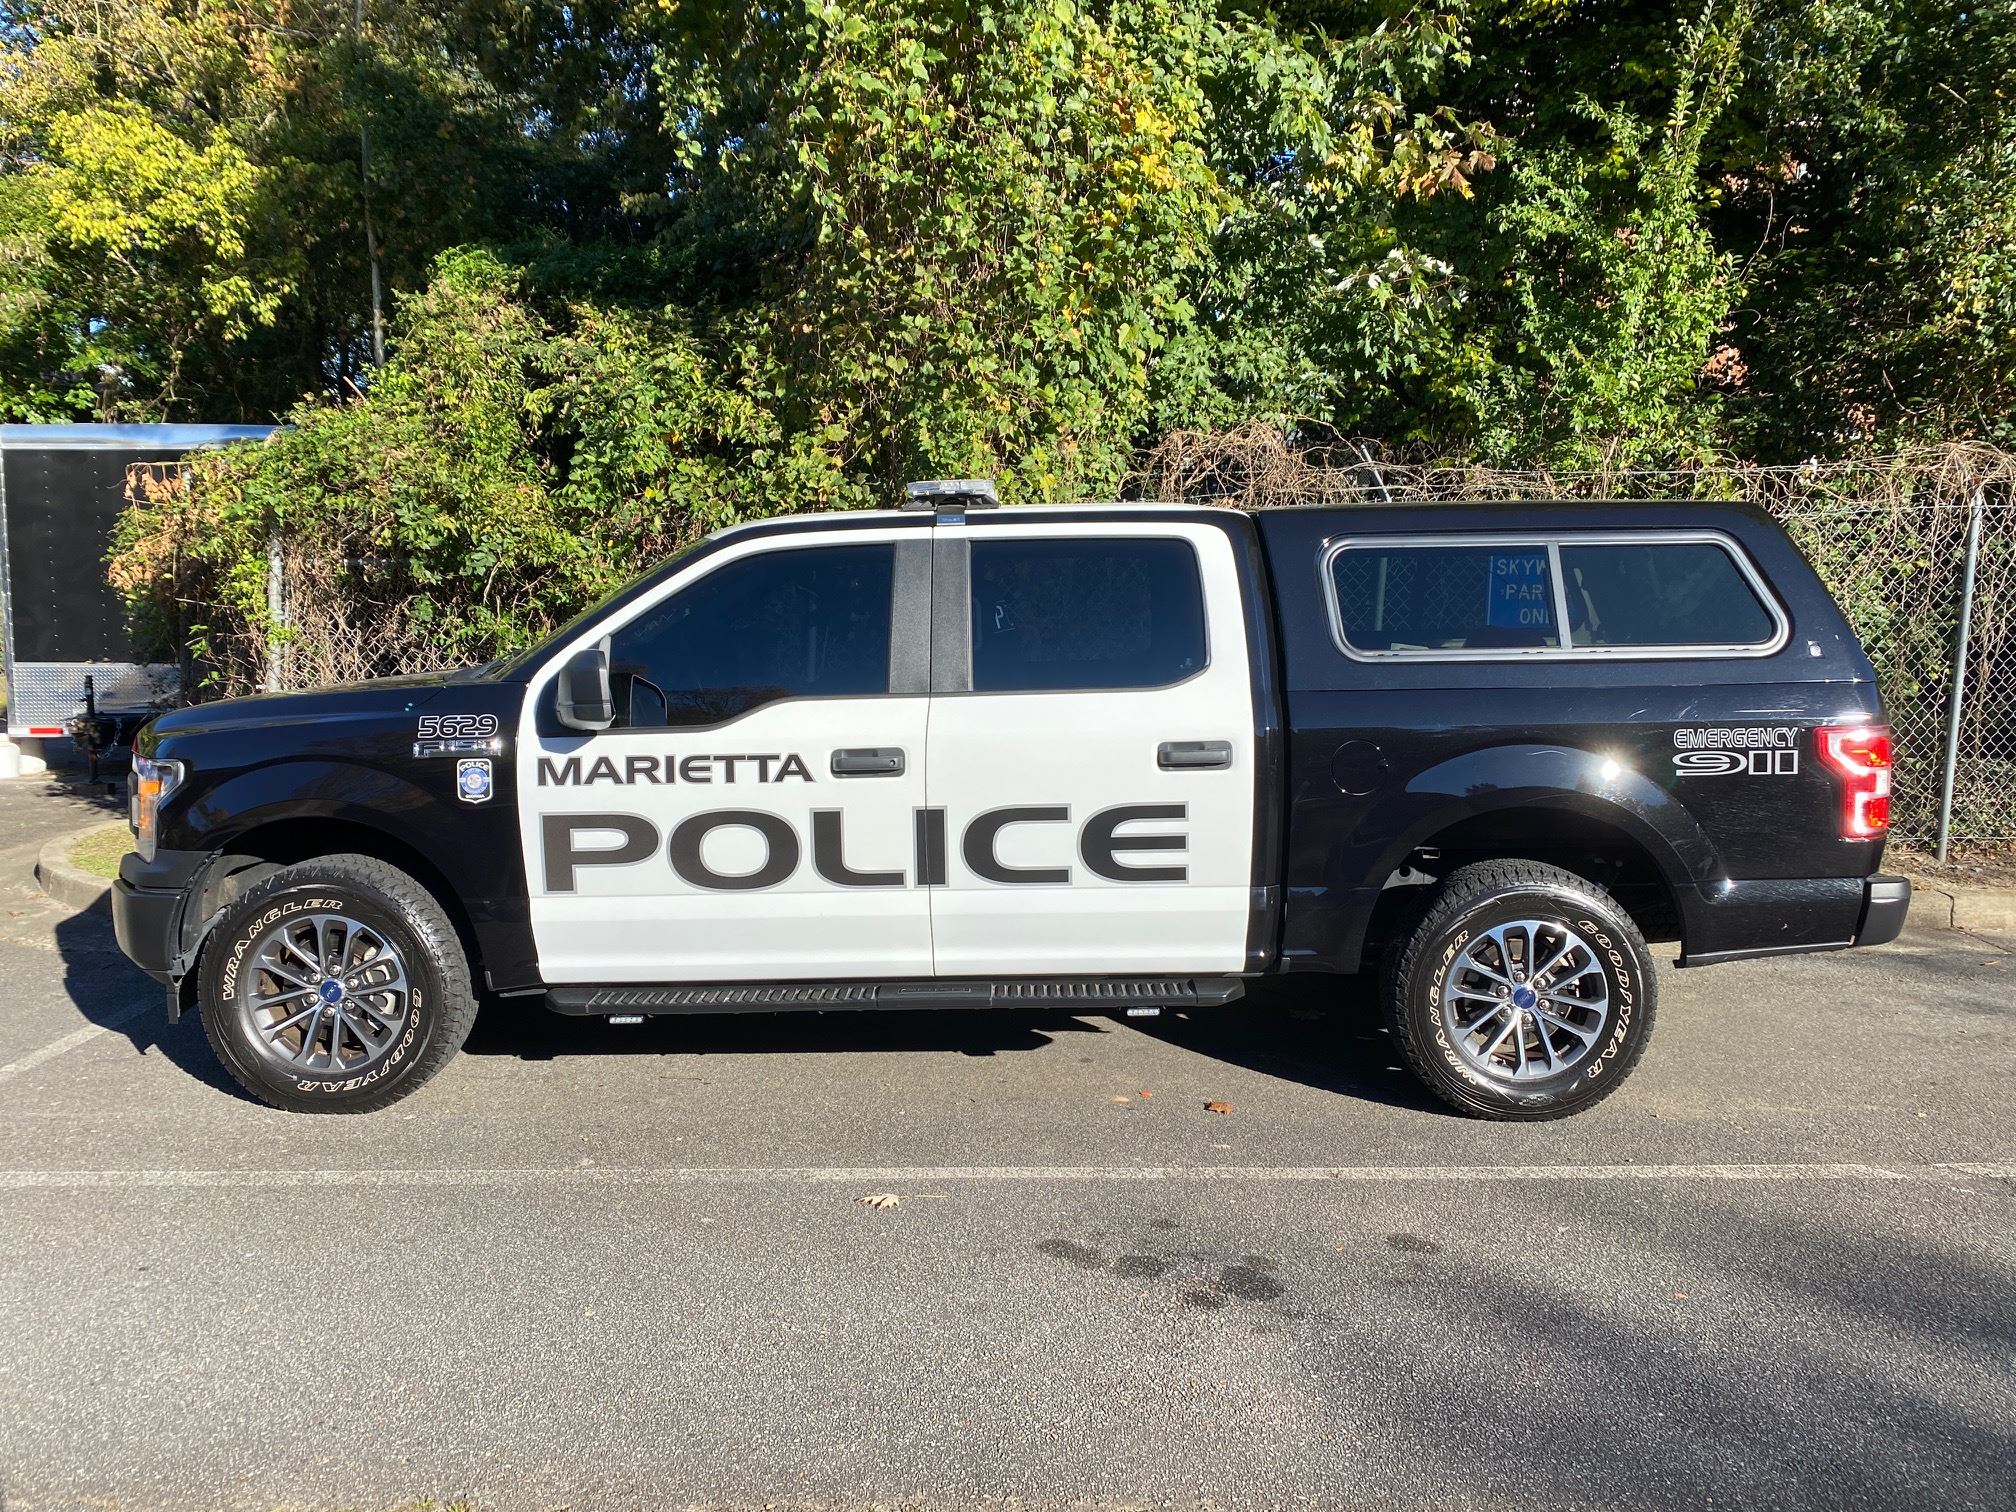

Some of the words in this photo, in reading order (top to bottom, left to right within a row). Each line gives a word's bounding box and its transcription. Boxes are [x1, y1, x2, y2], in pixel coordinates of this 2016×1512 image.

[1505, 583, 1543, 601] PAR
[417, 713, 499, 739] 5629
[1673, 727, 1799, 749] EMERGENCY
[459, 761, 490, 772] POLICE
[536, 754, 817, 787] MARIETTA
[1672, 749, 1799, 776] 911
[538, 803, 1190, 895] POLICE
[222, 898, 343, 1001] WRANGLER
[1427, 928, 1478, 1086] WRANGLER
[1577, 920, 1633, 1080] GOODYEAR
[297, 987, 423, 1093] GOODYEAR
